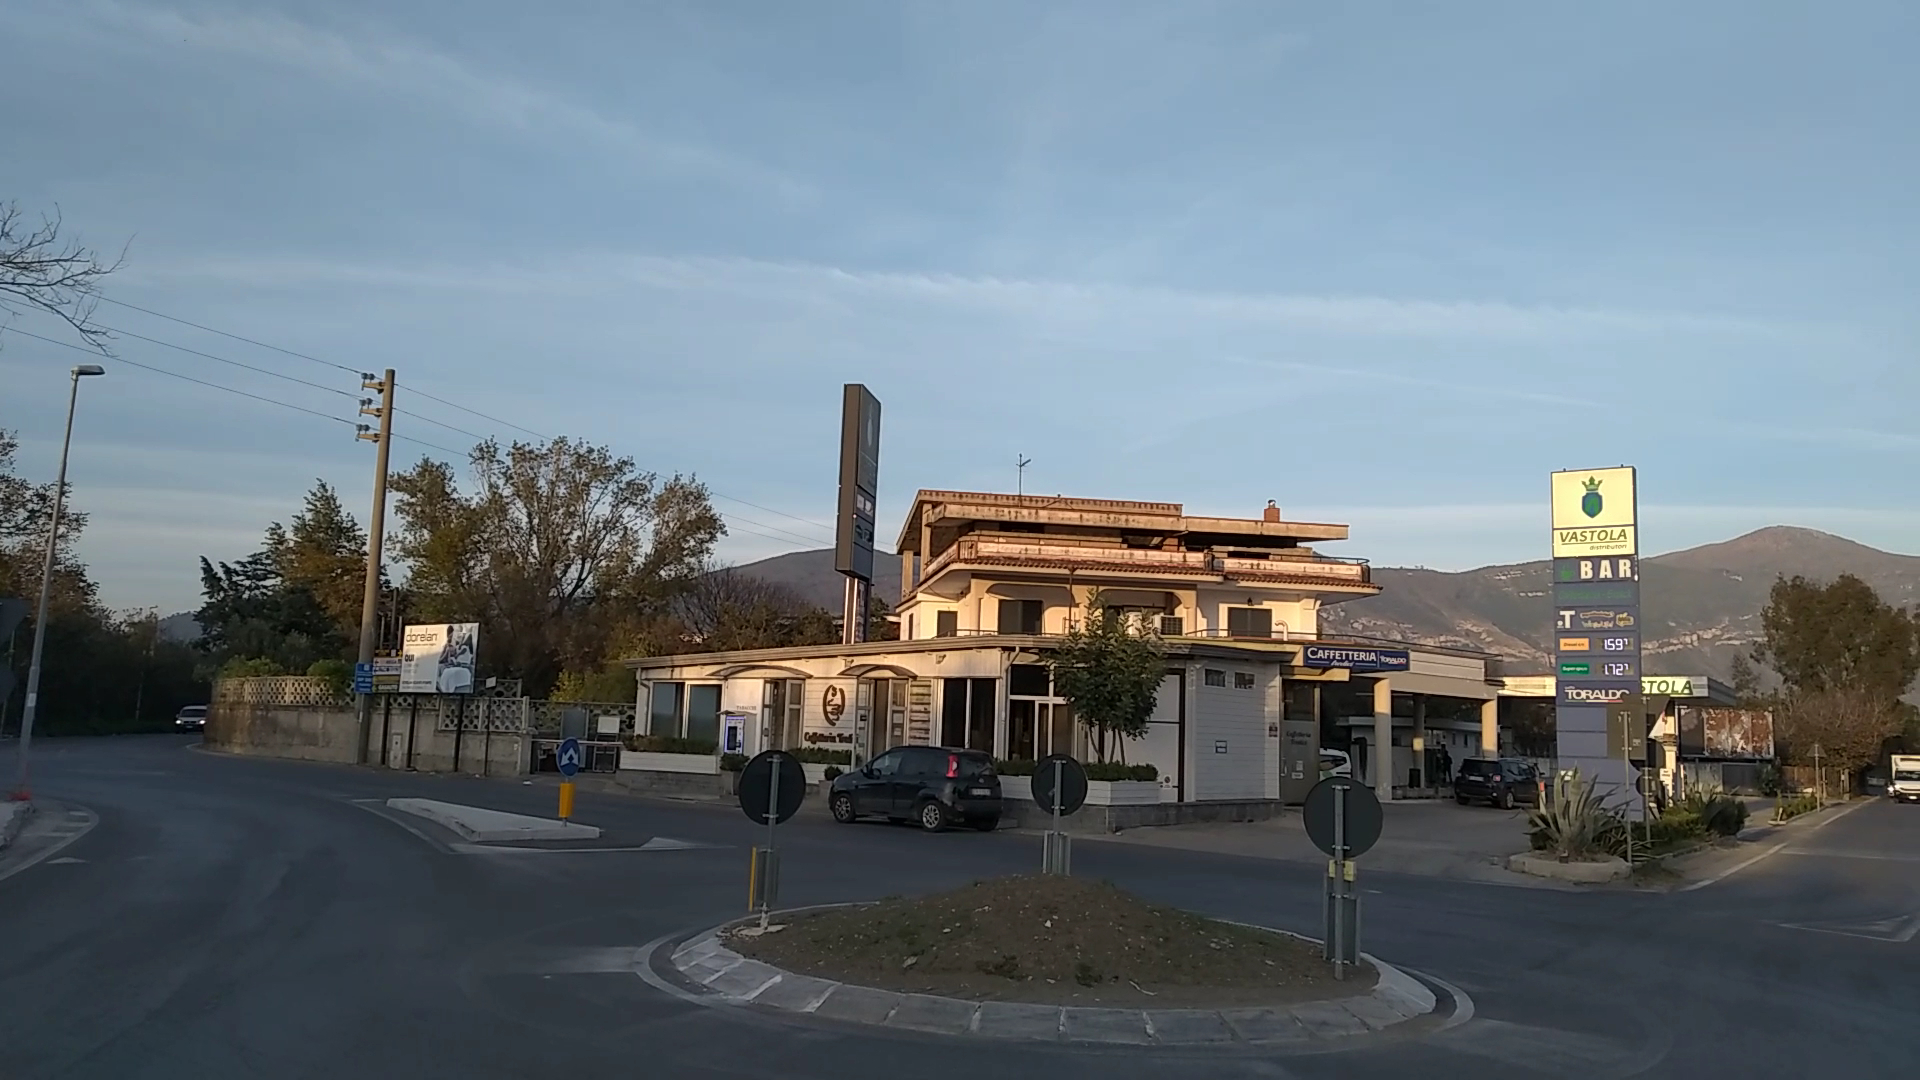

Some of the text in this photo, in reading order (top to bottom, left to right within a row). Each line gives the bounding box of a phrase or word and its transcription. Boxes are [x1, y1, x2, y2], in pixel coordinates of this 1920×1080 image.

[1559, 528, 1628, 543] VASTOLA
[1580, 558, 1632, 580] BAR
[405, 627, 438, 643] dorelan
[1307, 647, 1377, 662] CAFFETTERIA
